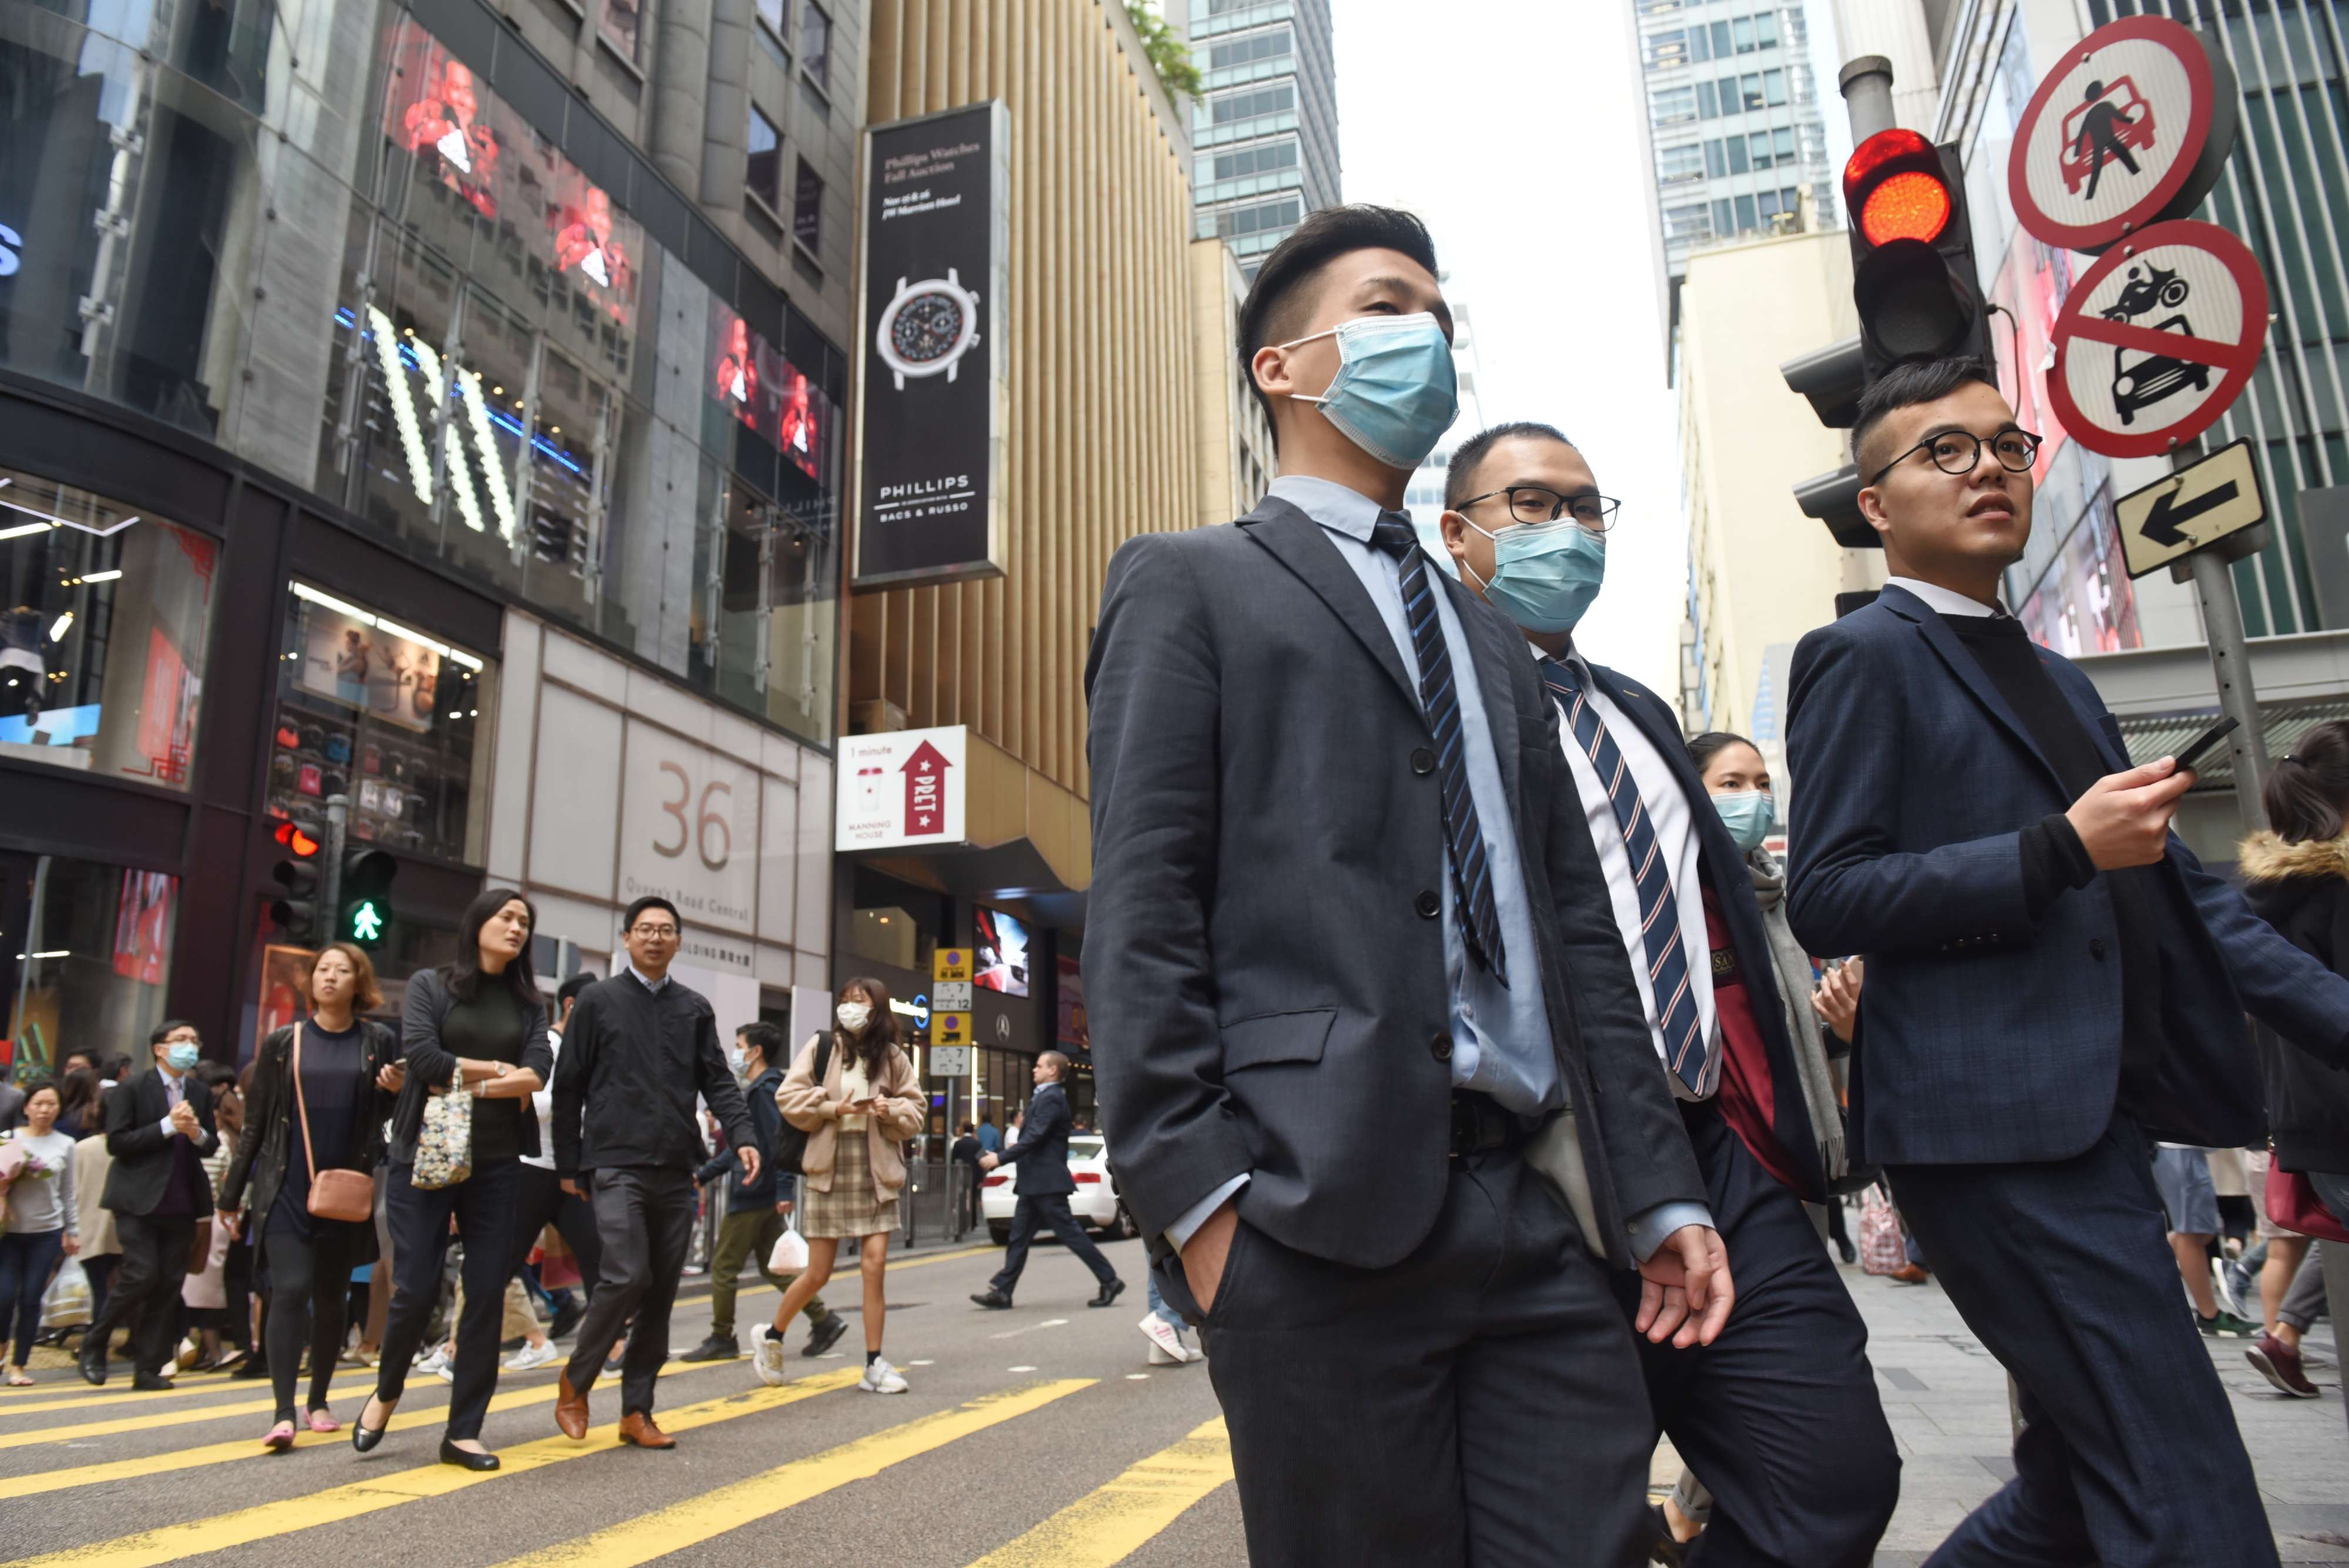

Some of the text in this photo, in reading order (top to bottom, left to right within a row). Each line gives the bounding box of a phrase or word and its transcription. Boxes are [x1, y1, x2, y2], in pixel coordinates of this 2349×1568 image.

[884, 143, 980, 170] Phillips Watches
[884, 161, 955, 184] Fall Auction
[880, 475, 968, 499] PHILLIPS
[880, 502, 968, 523] BACS & RUSSO
[859, 745, 892, 756] minute
[914, 775, 936, 812] PRET
[653, 761, 731, 872] 36
[849, 820, 891, 831] MANNING
[855, 830, 883, 840] HOUSE
[677, 889, 704, 910] Road
[708, 898, 748, 921] Central
[958, 983, 964, 993] 7
[958, 998, 969, 1008] 12
[956, 1048, 963, 1059] 7
[955, 1064, 963, 1074] 7
